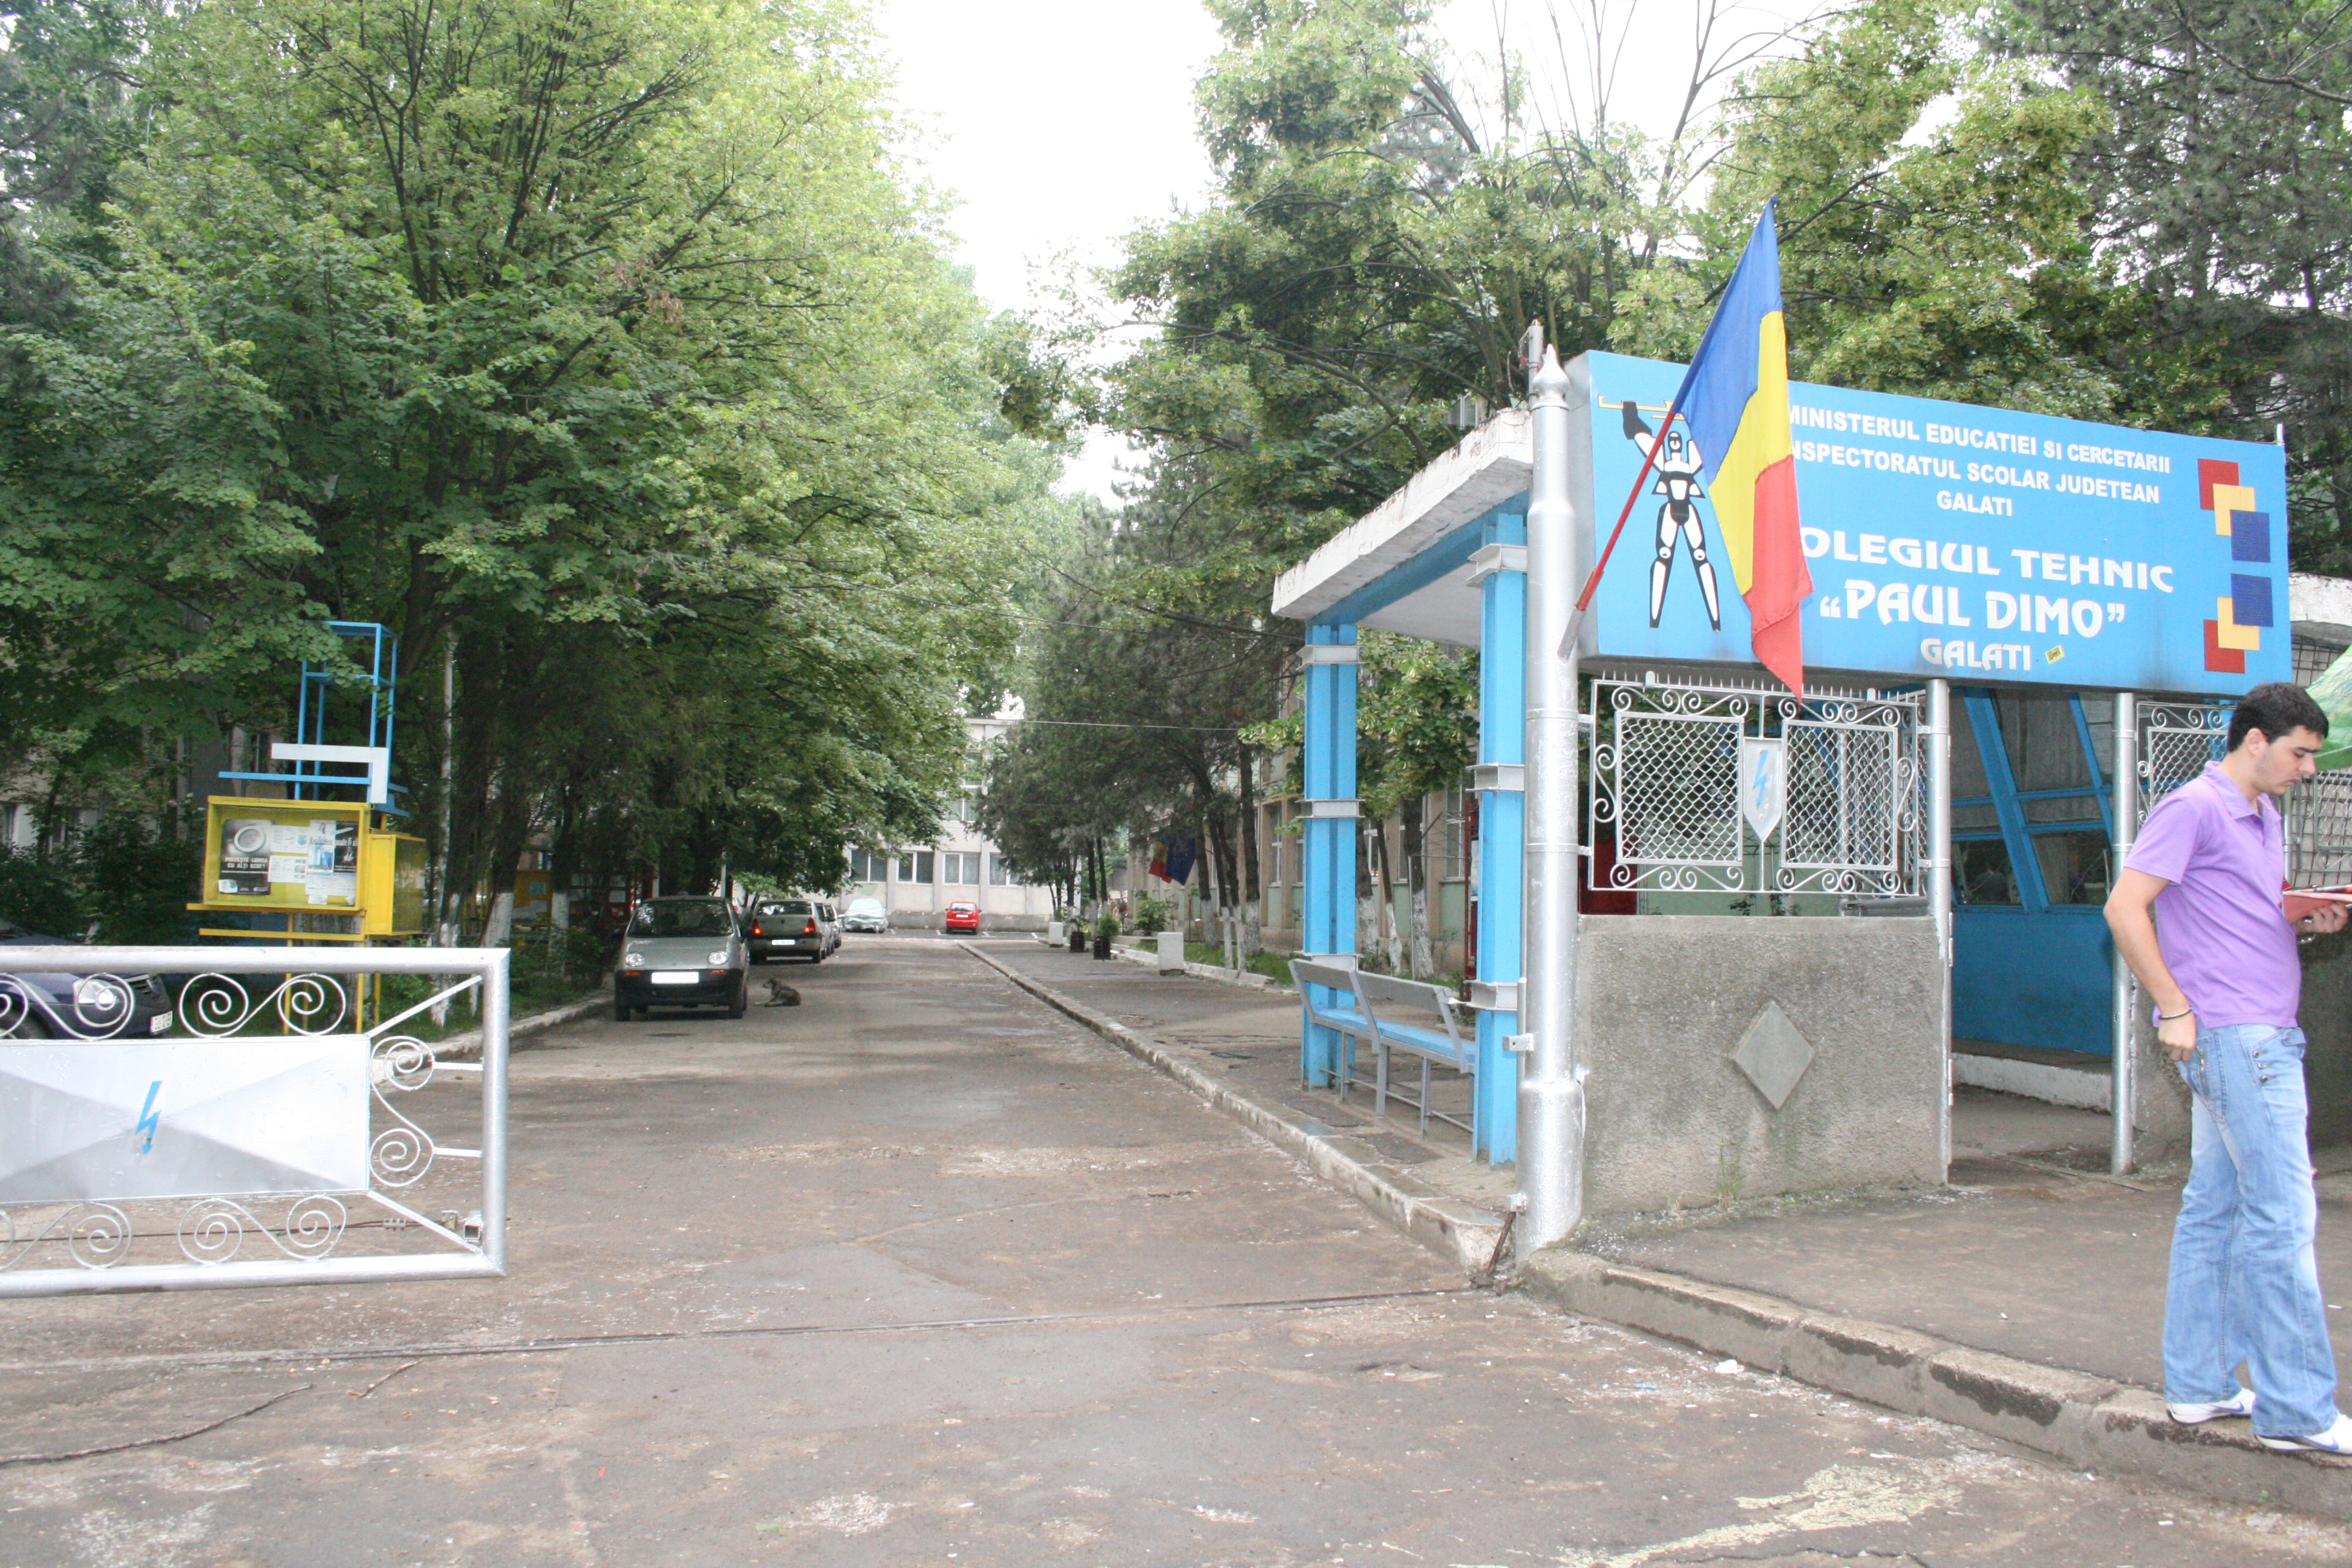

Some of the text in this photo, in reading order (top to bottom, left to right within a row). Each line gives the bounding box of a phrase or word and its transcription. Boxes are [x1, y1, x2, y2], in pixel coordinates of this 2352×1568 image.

[1792, 440, 2160, 503] NSPECTORATUL SCOLAR JUDETEAN
[1926, 423, 2036, 455] EDUCATIEI
[2043, 440, 2062, 460] SI
[2066, 443, 2171, 473] CERCETARII
[1937, 490, 2013, 516] GALATI
[1800, 527, 2174, 593] OLEGIUL TEHNIC
[1921, 638, 2031, 671] GALATI
